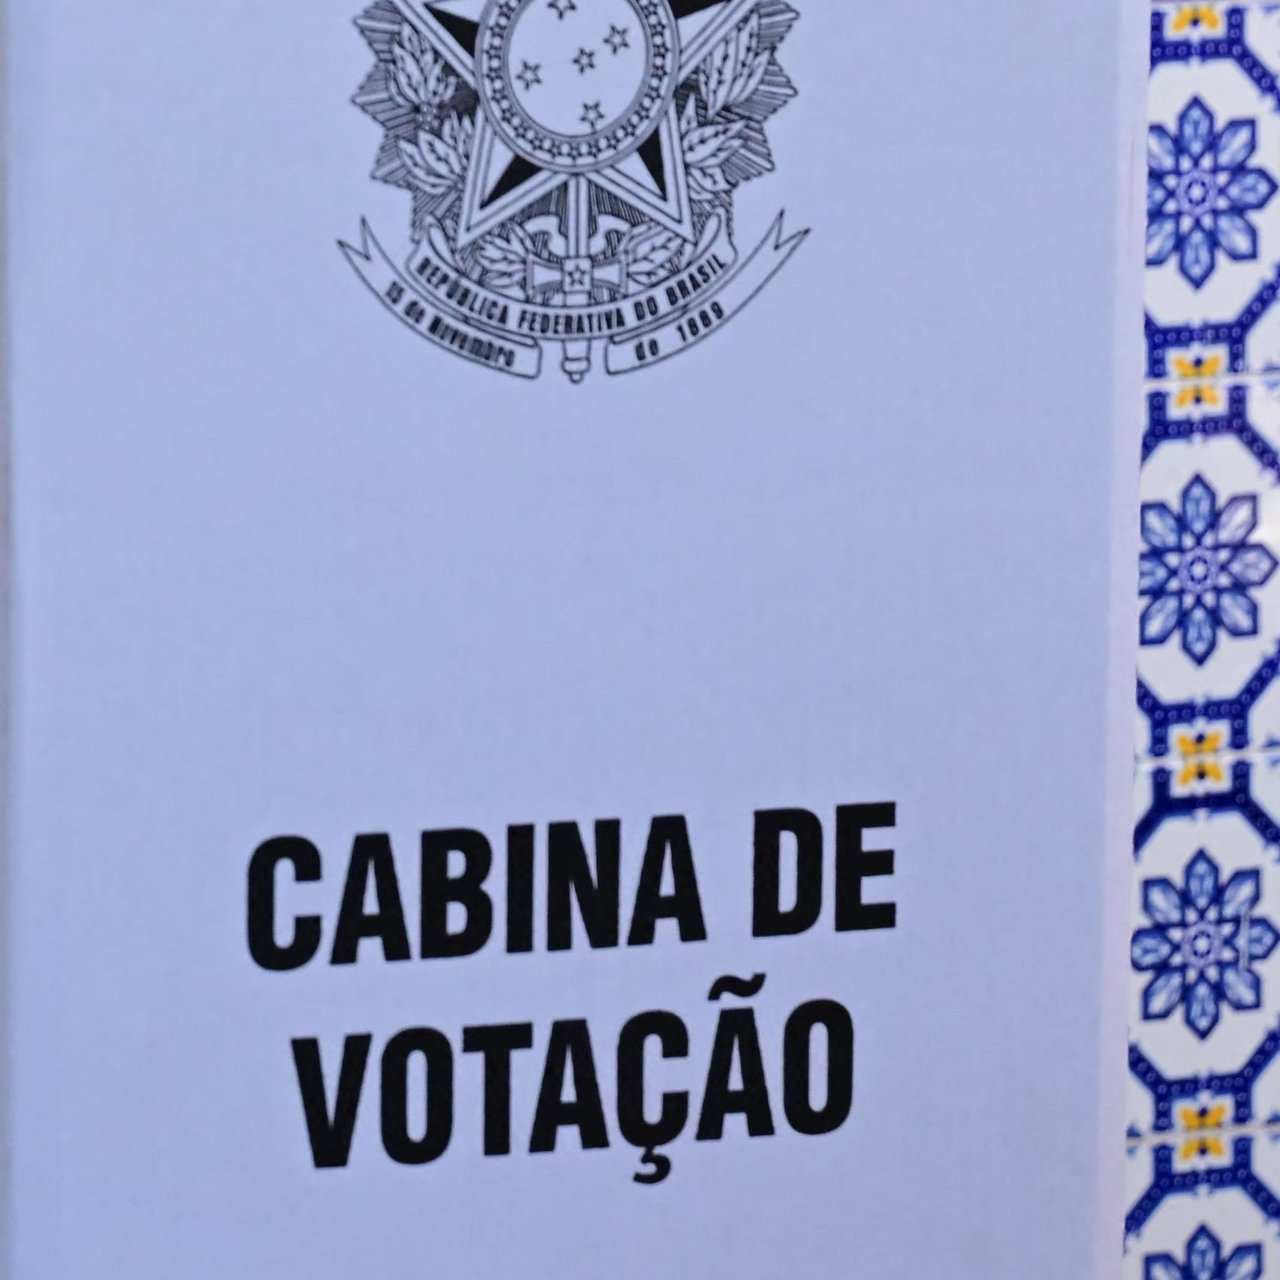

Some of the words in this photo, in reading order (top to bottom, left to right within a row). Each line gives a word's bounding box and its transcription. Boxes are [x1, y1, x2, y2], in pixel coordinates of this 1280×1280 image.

[518, 304, 626, 335] FEDERATIVA
[633, 296, 659, 322] DO
[665, 253, 728, 307] BRASIL
[246, 813, 706, 972] CABINA
[751, 801, 898, 938] DE
[289, 972, 857, 1185] VOTAÇÃO
